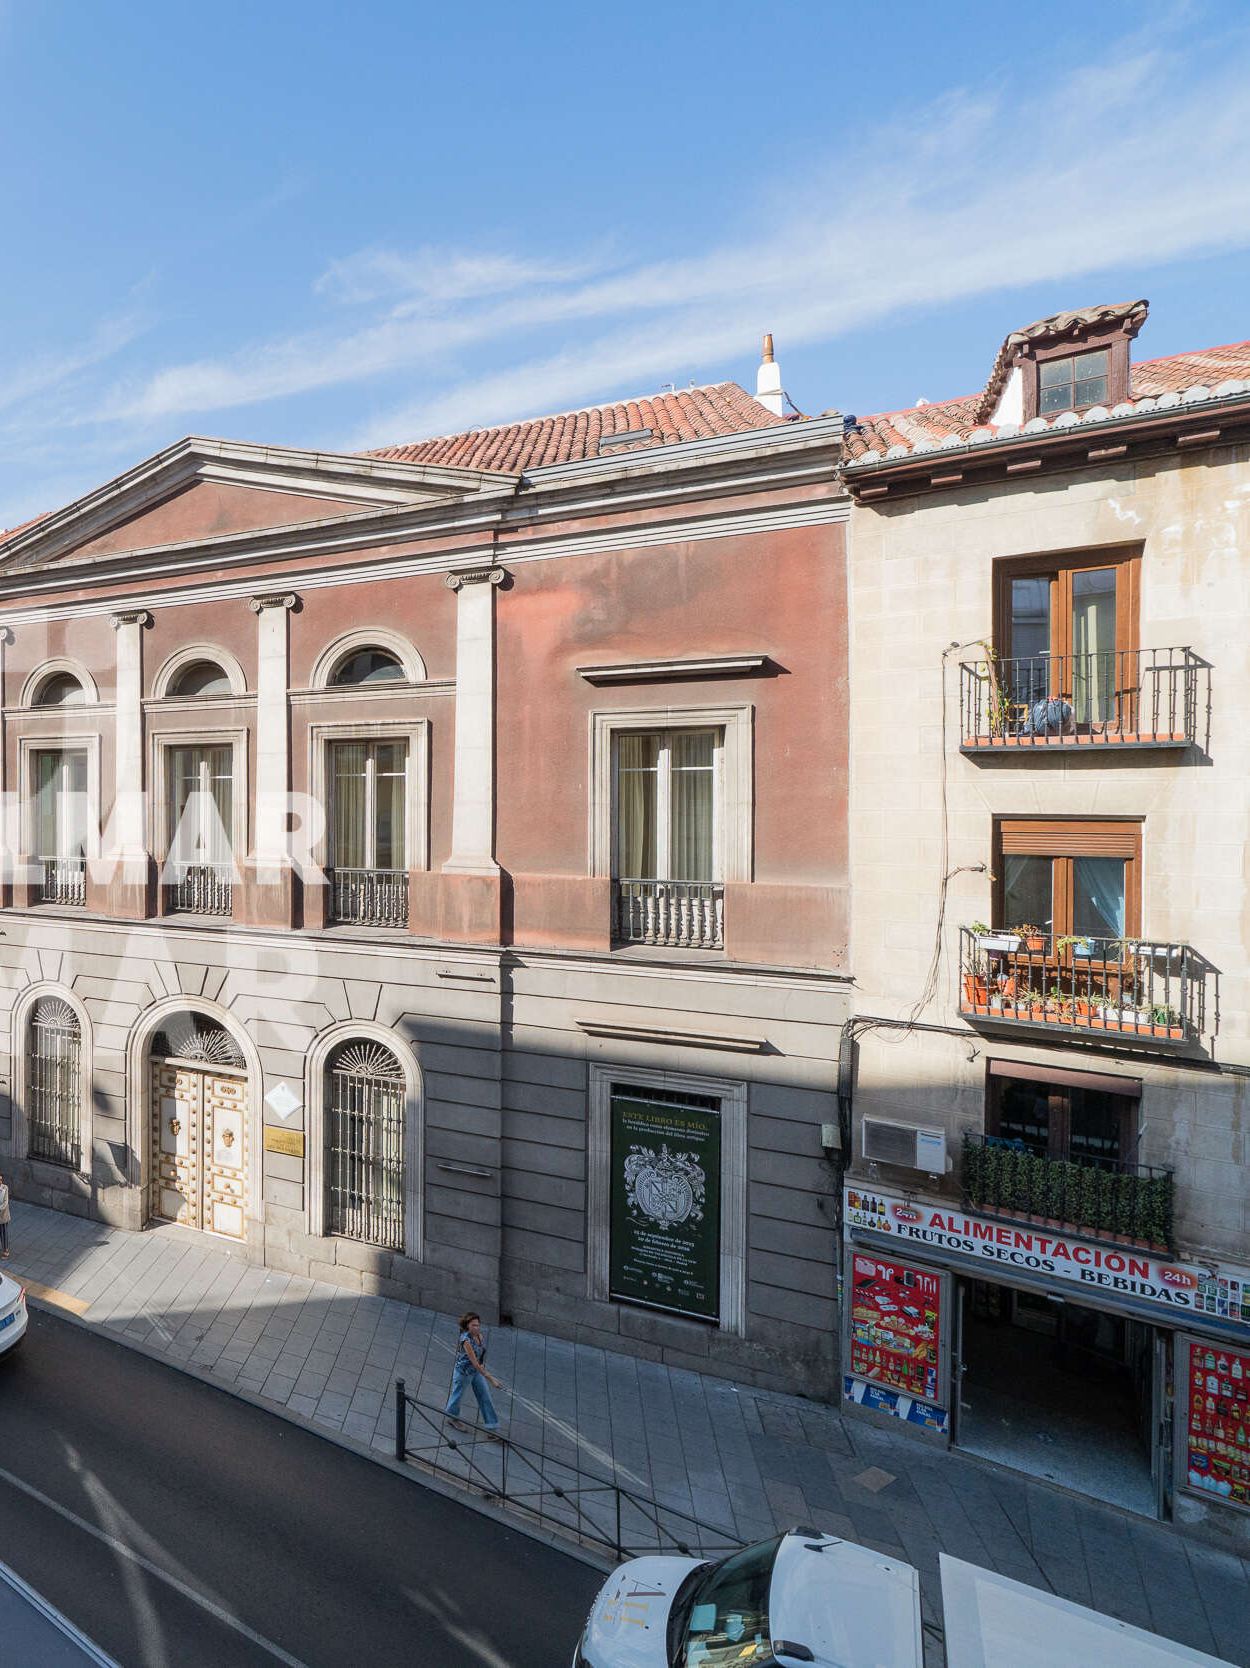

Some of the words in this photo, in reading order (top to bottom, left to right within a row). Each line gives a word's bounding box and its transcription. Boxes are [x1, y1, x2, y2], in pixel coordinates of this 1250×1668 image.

[897, 1223, 975, 1252] FRUTOS
[981, 1244, 1056, 1273] SECOS
[1080, 1267, 1191, 1306] BEBIDAS
[929, 1212, 1150, 1280] ALIMENTACIÓN
[1164, 1271, 1192, 1286] 24h
